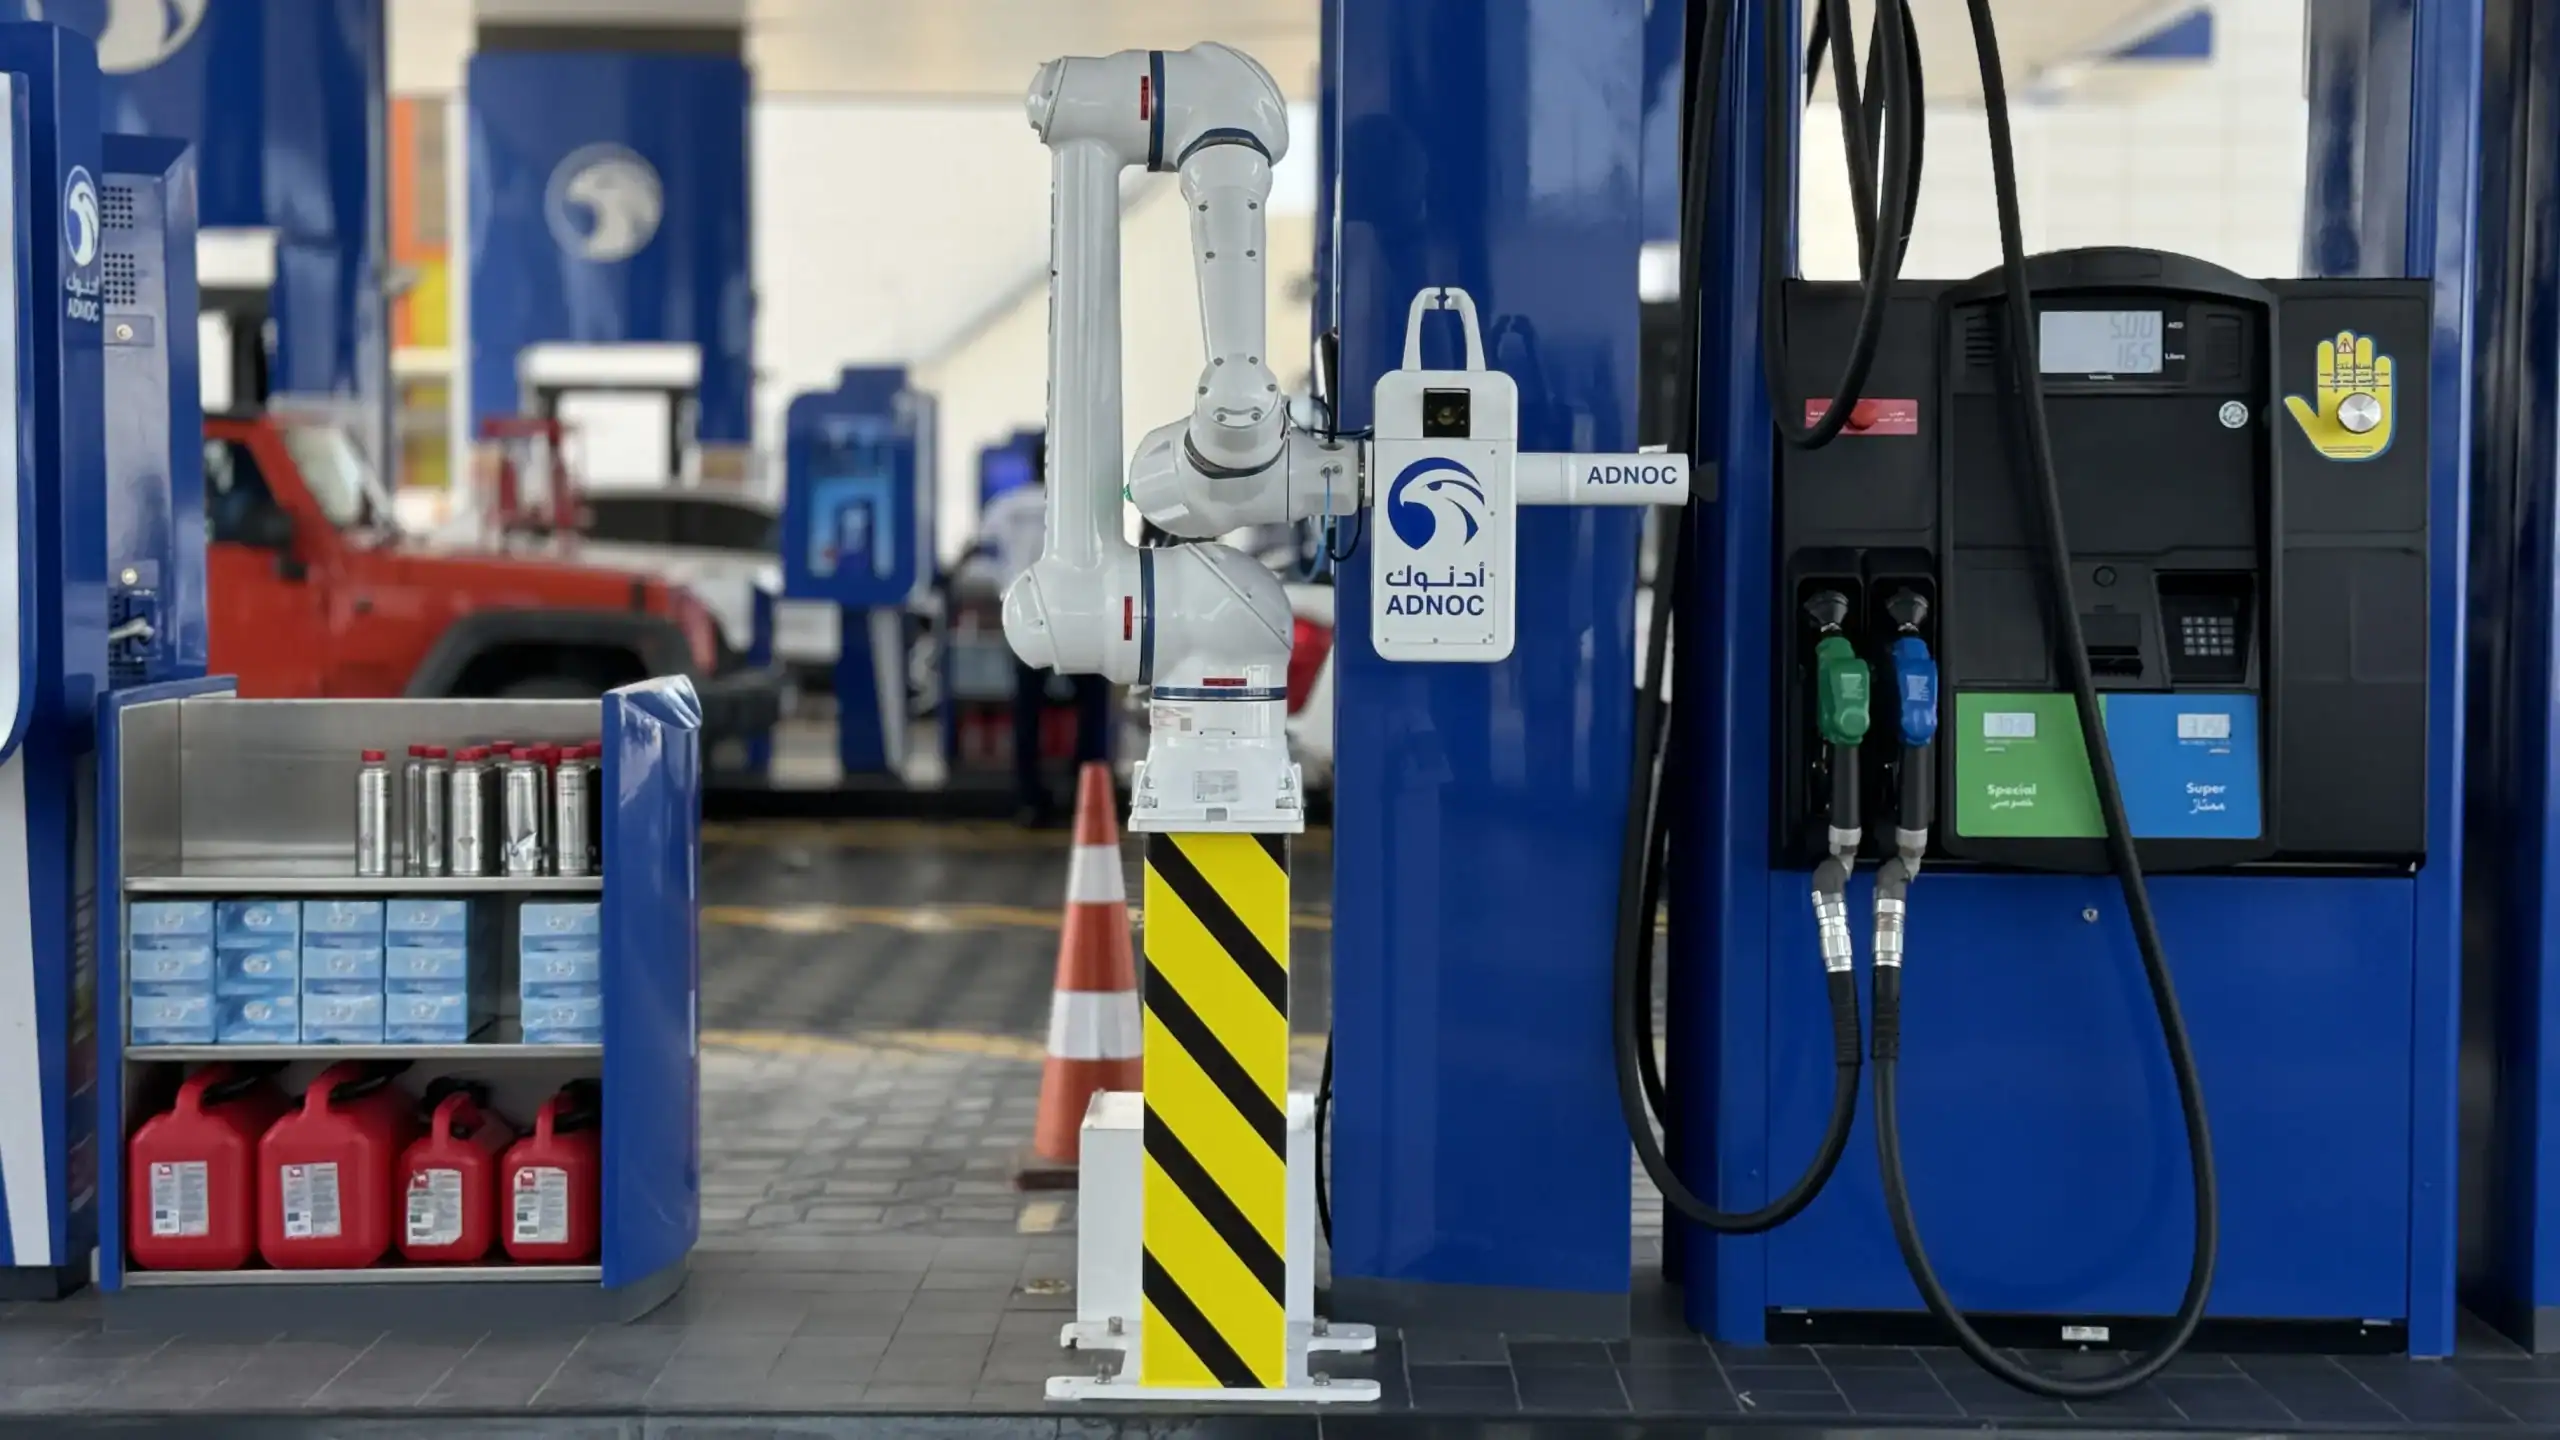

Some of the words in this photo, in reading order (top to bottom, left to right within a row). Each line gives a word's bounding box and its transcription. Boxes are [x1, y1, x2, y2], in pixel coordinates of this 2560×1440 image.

[1587, 466, 1678, 485] ADNOC
[1385, 561, 1485, 593] أدنوك
[1385, 595, 1485, 616] ADNOC
[1986, 782, 2037, 798] Special
[2186, 782, 2227, 796] Super
